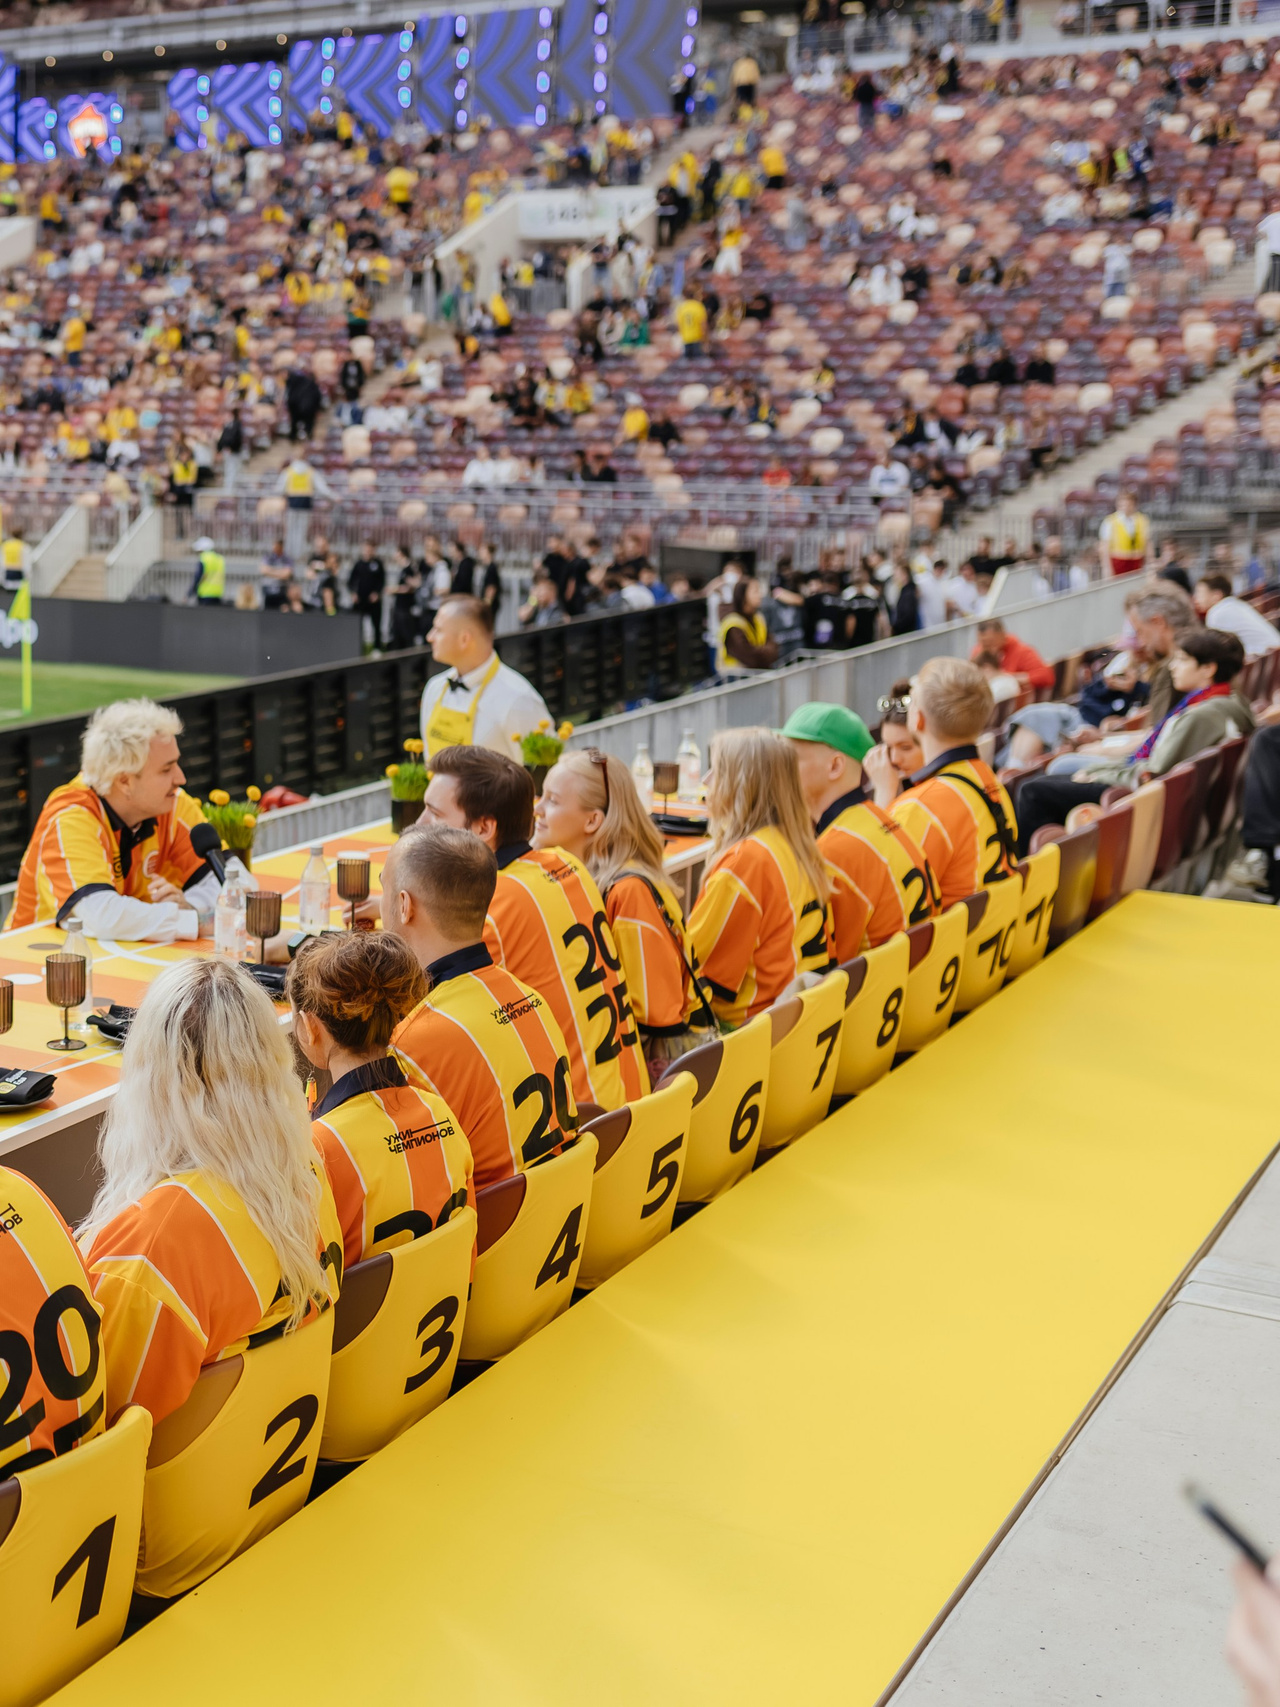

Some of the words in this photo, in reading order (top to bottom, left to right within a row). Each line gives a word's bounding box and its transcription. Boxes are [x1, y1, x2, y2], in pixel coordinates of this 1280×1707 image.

[562, 910, 621, 992] 20
[934, 955, 960, 1013] 9
[978, 919, 1017, 979] 10
[496, 998, 542, 1026] ЧЕМПИОНОВ
[586, 981, 637, 1065] 25
[876, 987, 904, 1048] 8
[811, 1020, 841, 1093] 7
[388, 1126, 455, 1154] ЧЕМПИОНОВ
[512, 1055, 580, 1164] 20
[728, 1080, 763, 1155] 6
[640, 1134, 683, 1219] 5
[534, 1203, 584, 1291] 4
[404, 1295, 459, 1394] 3
[248, 1394, 319, 1510] 2
[51, 1514, 117, 1630] 1
